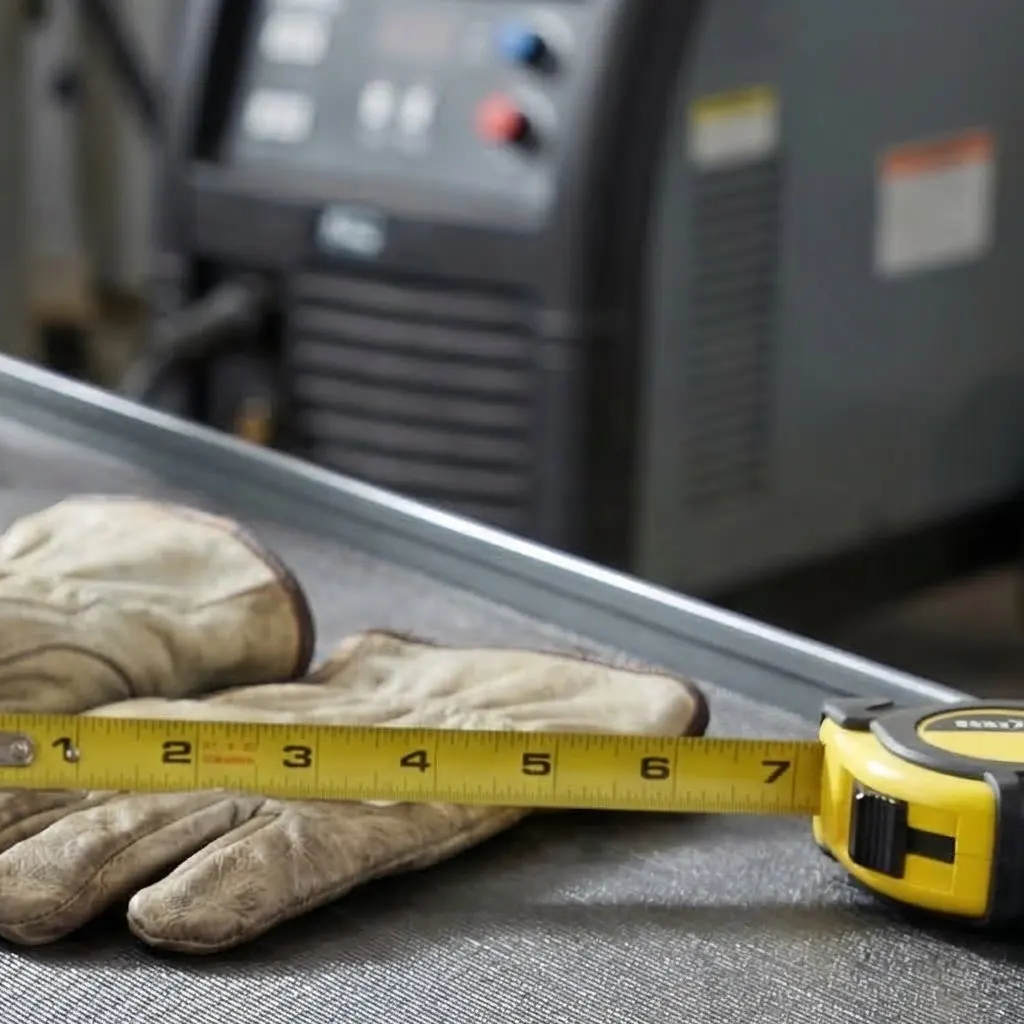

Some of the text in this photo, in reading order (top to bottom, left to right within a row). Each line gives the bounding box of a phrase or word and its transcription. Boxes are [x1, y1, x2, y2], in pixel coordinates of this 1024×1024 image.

[162, 740, 192, 764] 2
[283, 745, 312, 768] 3
[400, 750, 431, 772] 4
[522, 752, 551, 776] 5
[640, 756, 670, 780] 6
[761, 760, 791, 784] 7
